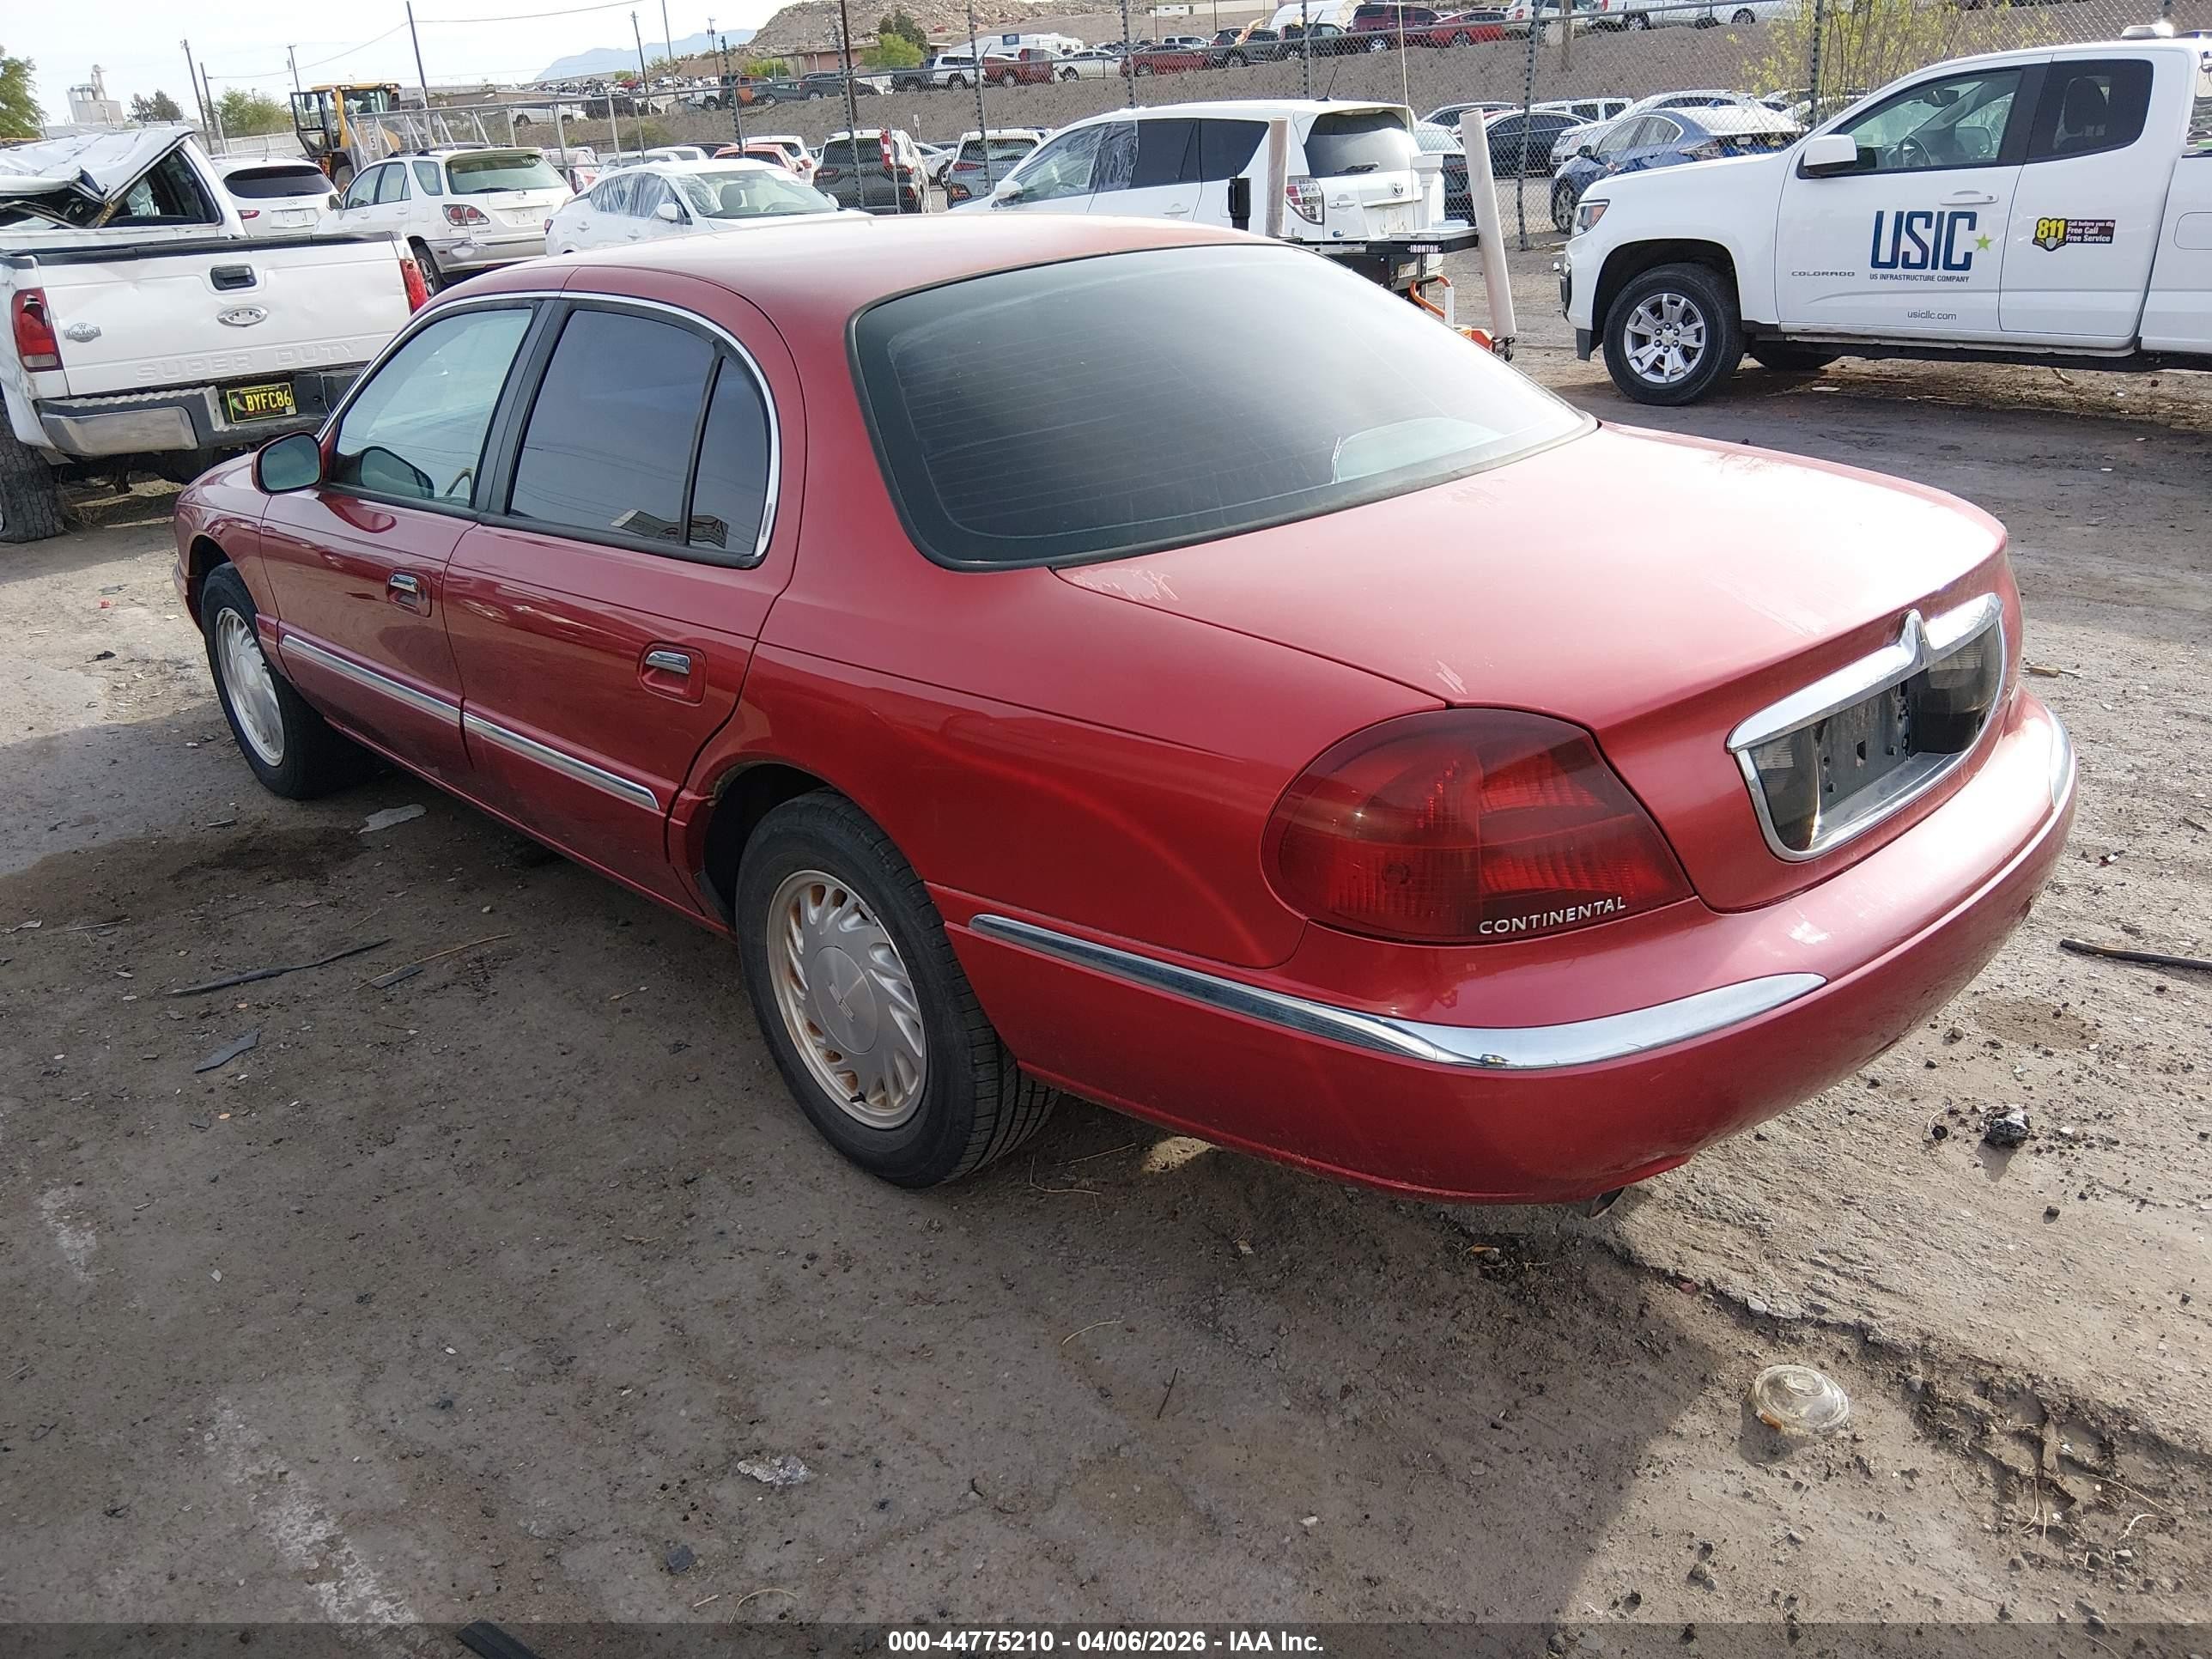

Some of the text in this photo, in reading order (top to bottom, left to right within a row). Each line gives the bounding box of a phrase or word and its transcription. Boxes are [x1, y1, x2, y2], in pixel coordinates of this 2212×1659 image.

[1870, 210, 1978, 270] USIC
[2037, 219, 2065, 239] 811
[1879, 273, 1936, 282] INFRASTRUCTURE
[1907, 309, 1957, 320] usicllc.com
[136, 342, 356, 382] SUPER DUTY
[245, 390, 292, 412] BYFC86
[1479, 896, 1626, 934] CONTINENTAL
